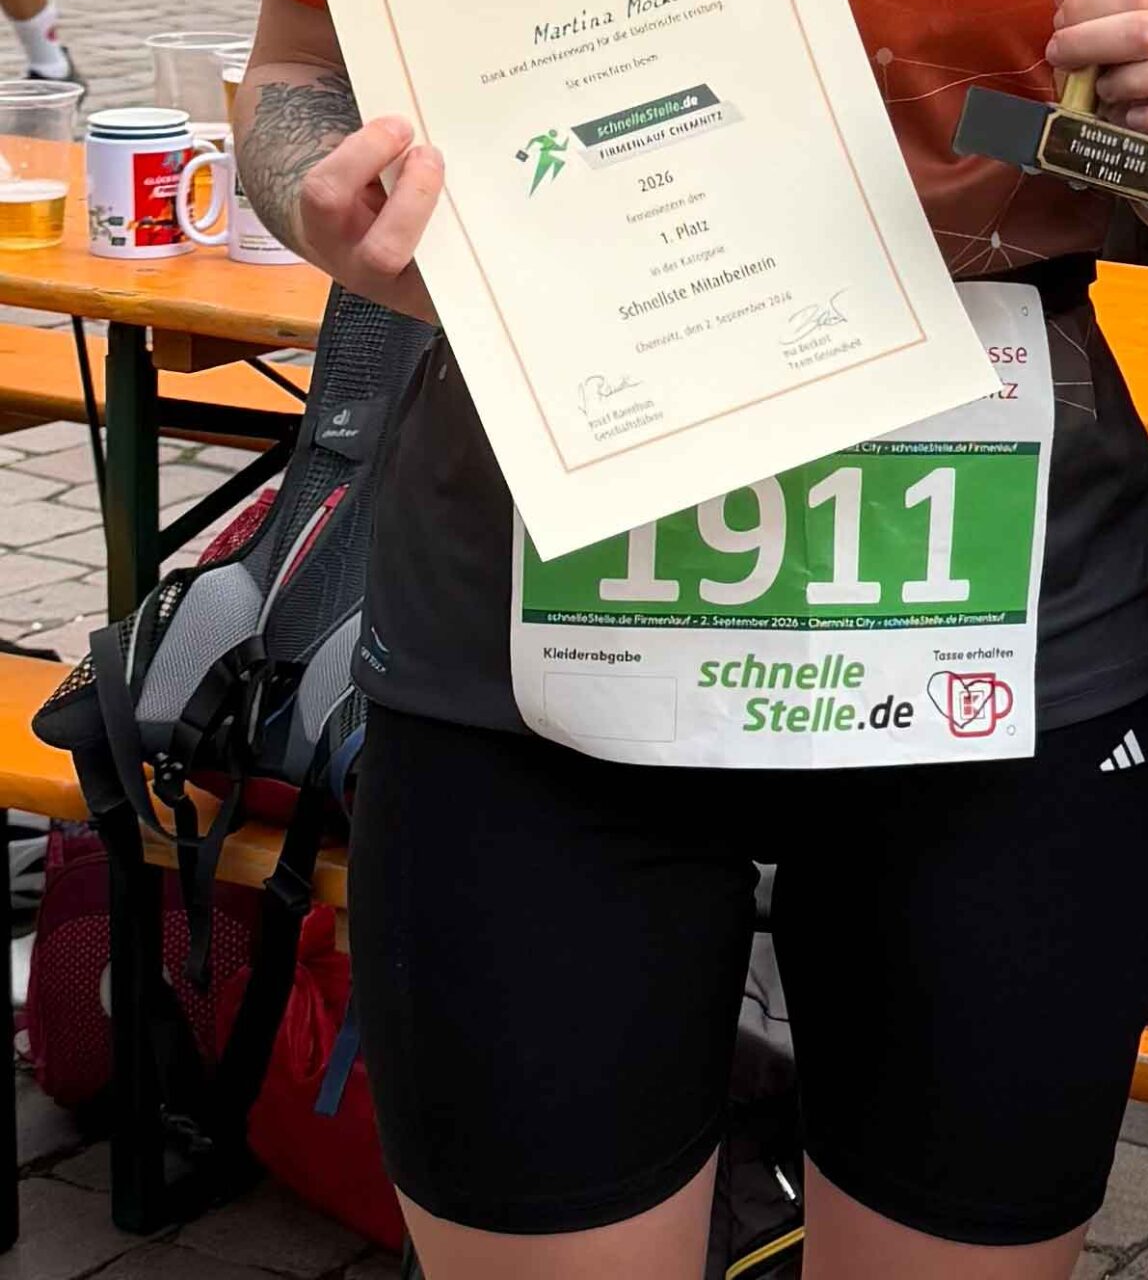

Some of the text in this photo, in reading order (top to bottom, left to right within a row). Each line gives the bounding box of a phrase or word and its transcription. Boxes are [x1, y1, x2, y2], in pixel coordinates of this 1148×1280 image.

[533, 9, 614, 45] Martina
[597, 95, 699, 138] schnelleStelle.de
[600, 111, 724, 160] FIRMENLAUF CHEMNITZ
[638, 170, 674, 192] 2026
[675, 219, 710, 240] Platz
[618, 256, 777, 321] Schnellste Mitarbeiterin
[598, 467, 970, 606] 1911
[712, 616, 770, 630] September
[808, 618, 854, 630] Chemnitz
[855, 617, 876, 630] City
[543, 647, 642, 664] Kleiderabgabe
[697, 654, 865, 690] schnelle
[933, 648, 1014, 661] Tasse erhalten
[742, 694, 914, 734] Stelle.de
